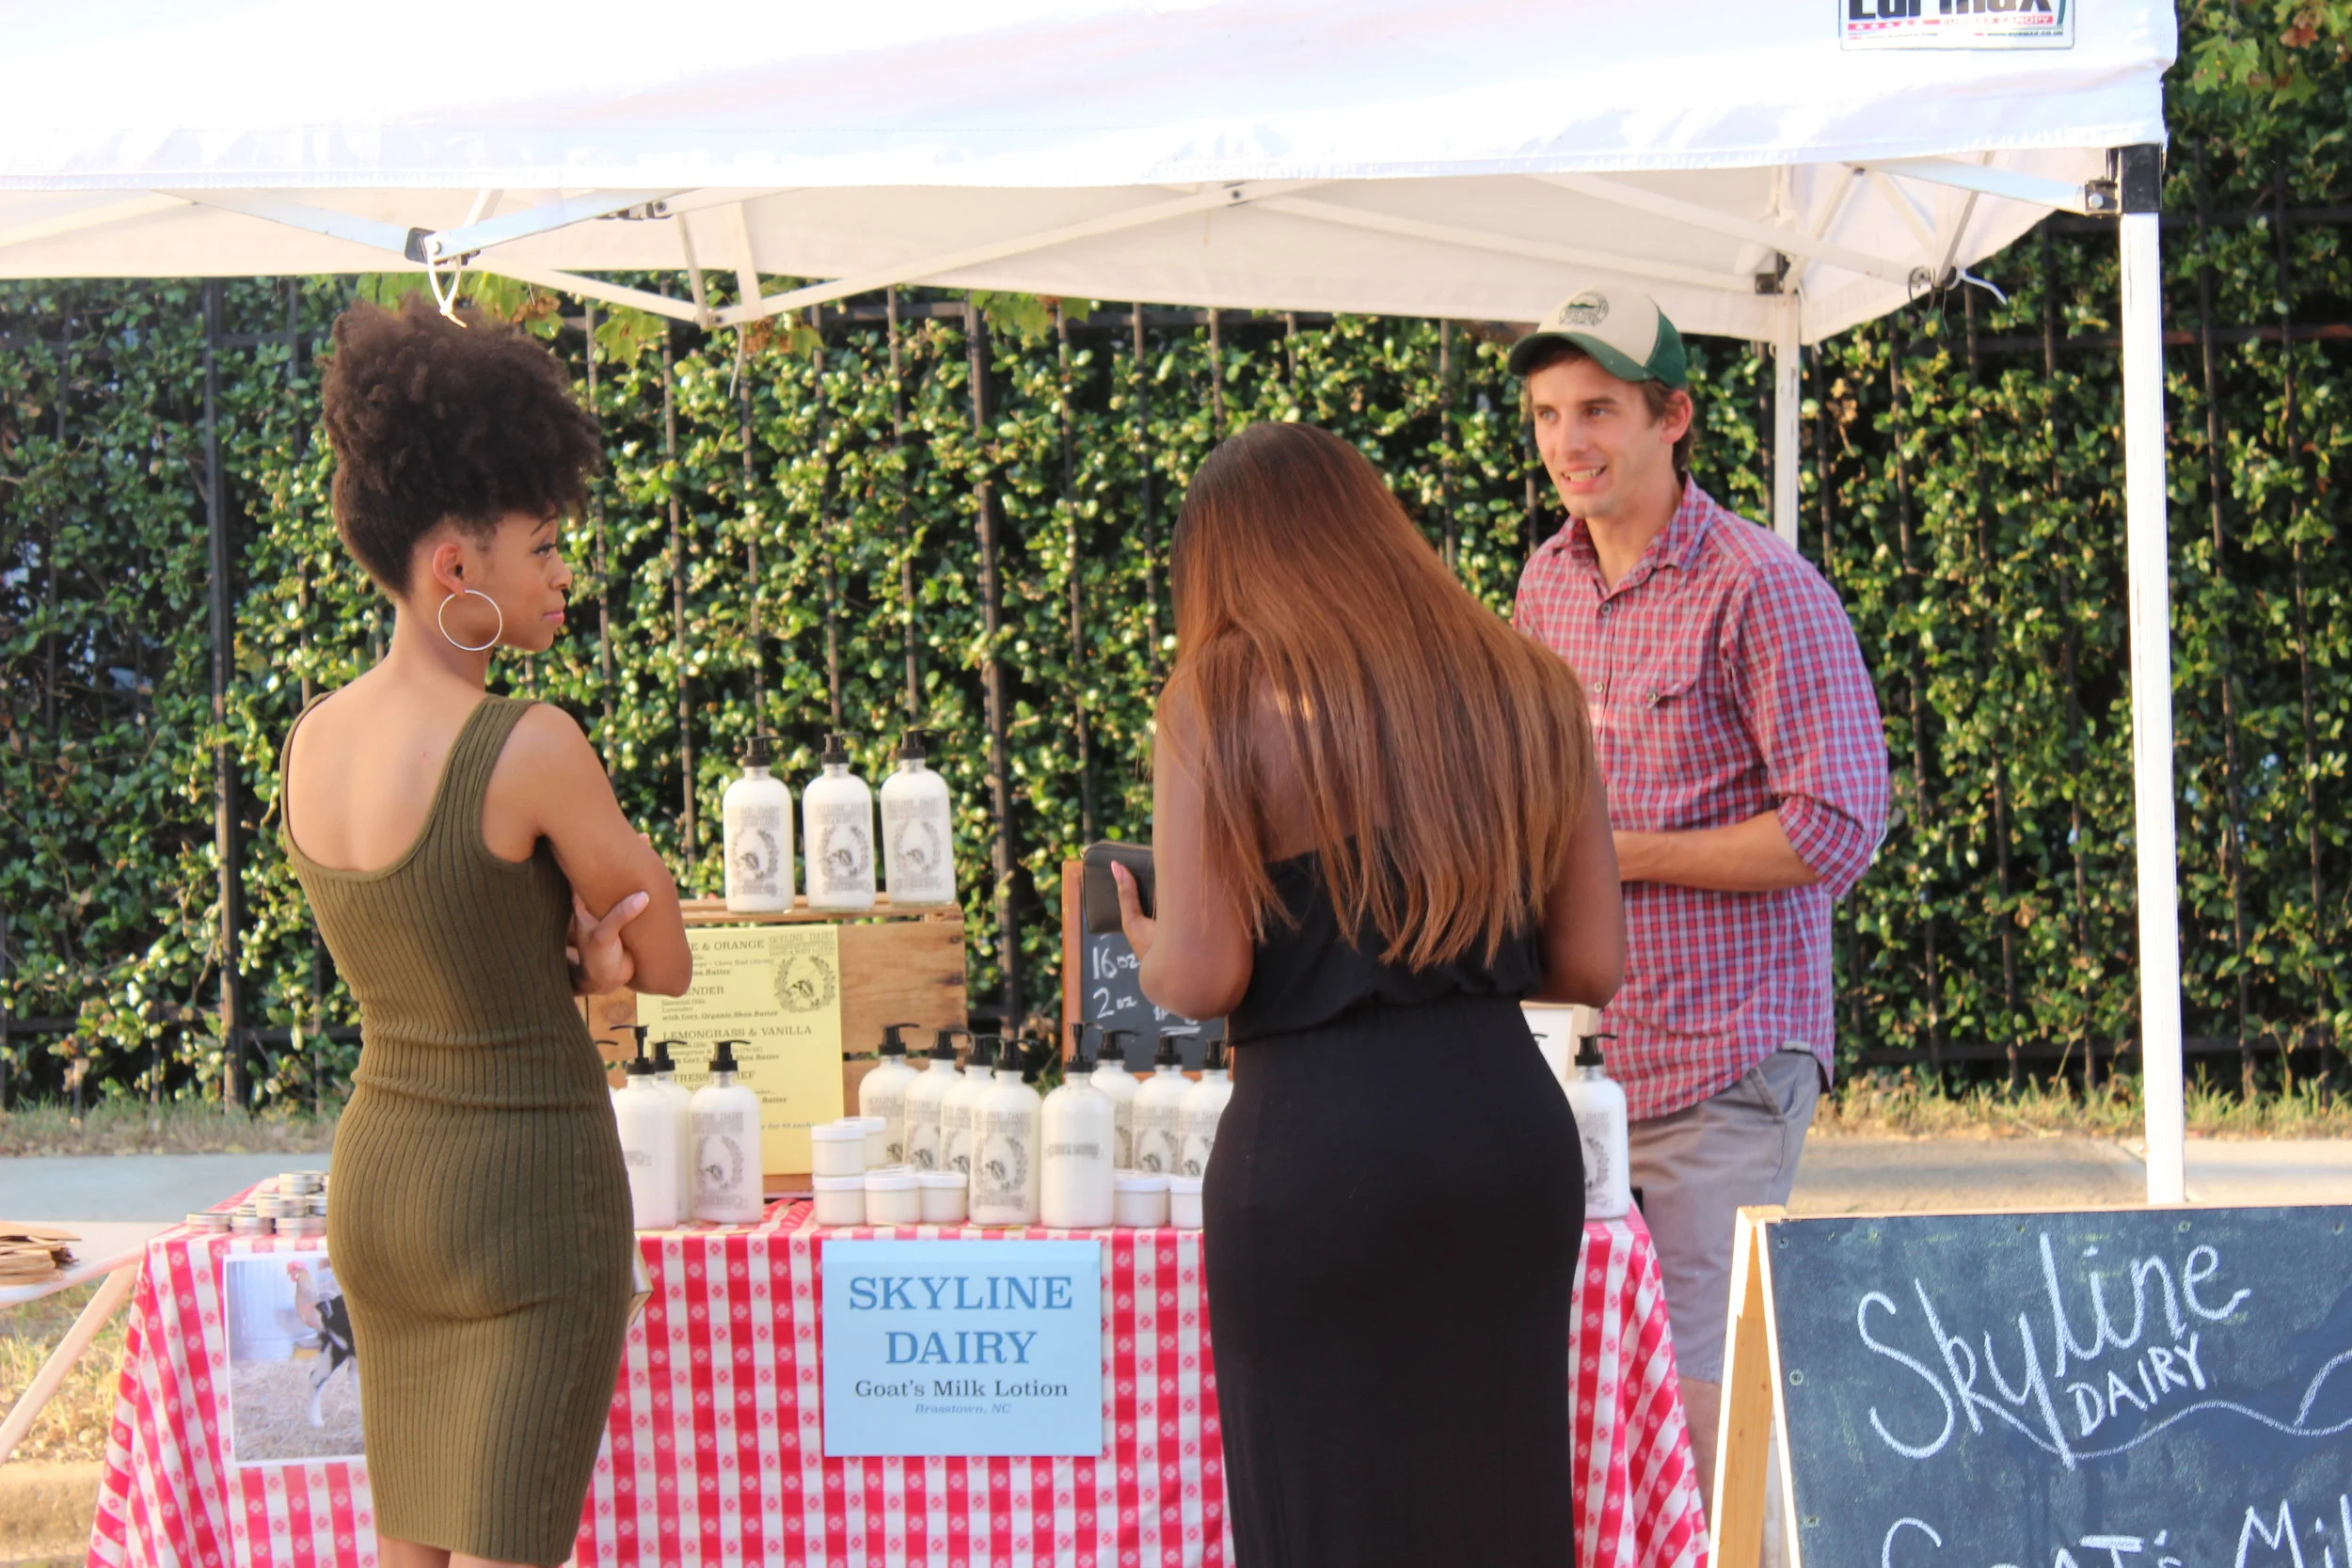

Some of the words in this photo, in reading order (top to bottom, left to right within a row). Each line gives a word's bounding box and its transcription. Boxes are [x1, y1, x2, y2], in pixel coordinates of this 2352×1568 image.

[714, 941, 765, 951] ORANGE
[687, 986, 724, 996] ENDER
[662, 1028, 746, 1040] LEMONGRASS
[748, 1027, 758, 1037] &
[761, 1025, 812, 1036] VANILLA
[673, 1071, 709, 1083] TRESS
[737, 1070, 756, 1081] IEF
[849, 1275, 1073, 1310] SKYLINE
[884, 1331, 1038, 1364] DAIRY
[1856, 1231, 2252, 1471] Skyline
[855, 1380, 925, 1398] Goat's
[933, 1379, 985, 1397] Milk
[994, 1379, 1069, 1397] Lotion
[2065, 1332, 2207, 1437] DAIRY
[914, 1402, 988, 1415] Brasstown,
[991, 1403, 1012, 1414] NC
